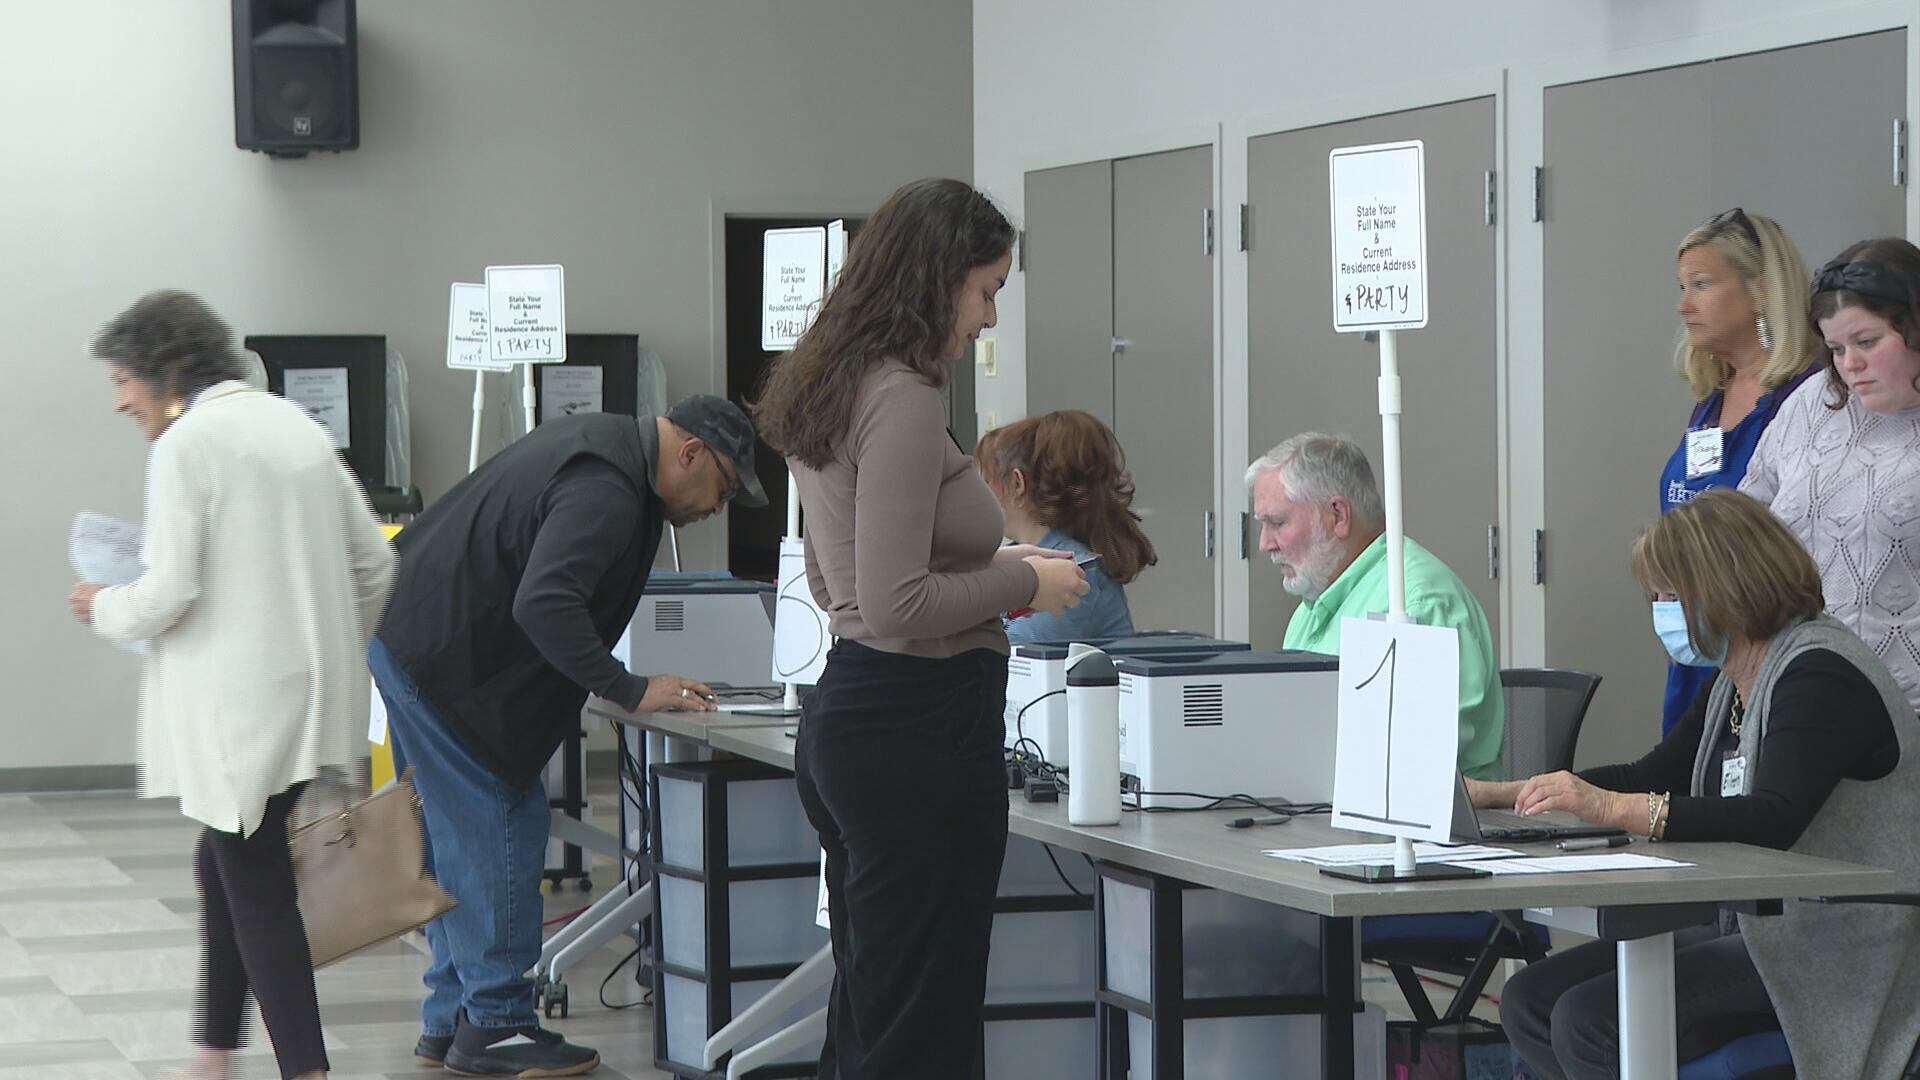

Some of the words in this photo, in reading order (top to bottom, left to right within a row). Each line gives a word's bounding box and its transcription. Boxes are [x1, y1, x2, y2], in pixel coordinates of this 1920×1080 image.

[1357, 205, 1377, 218] State
[1379, 203, 1396, 215] Your
[1358, 220, 1372, 231] Full
[1374, 218, 1396, 230] Name
[1374, 232, 1380, 244] &
[1363, 246, 1392, 259] Current
[781, 266, 794, 275] State
[795, 266, 806, 274] Your
[1341, 262, 1381, 275] Residence
[1383, 260, 1416, 272] Address
[781, 276, 790, 284] Full
[791, 276, 805, 284] Name
[784, 294, 803, 303] Current
[1356, 283, 1409, 314] PARTY
[769, 304, 795, 312] Residence
[796, 303, 817, 312] Addss
[506, 337, 551, 355] PARTY
[1339, 637, 1431, 829] 1
